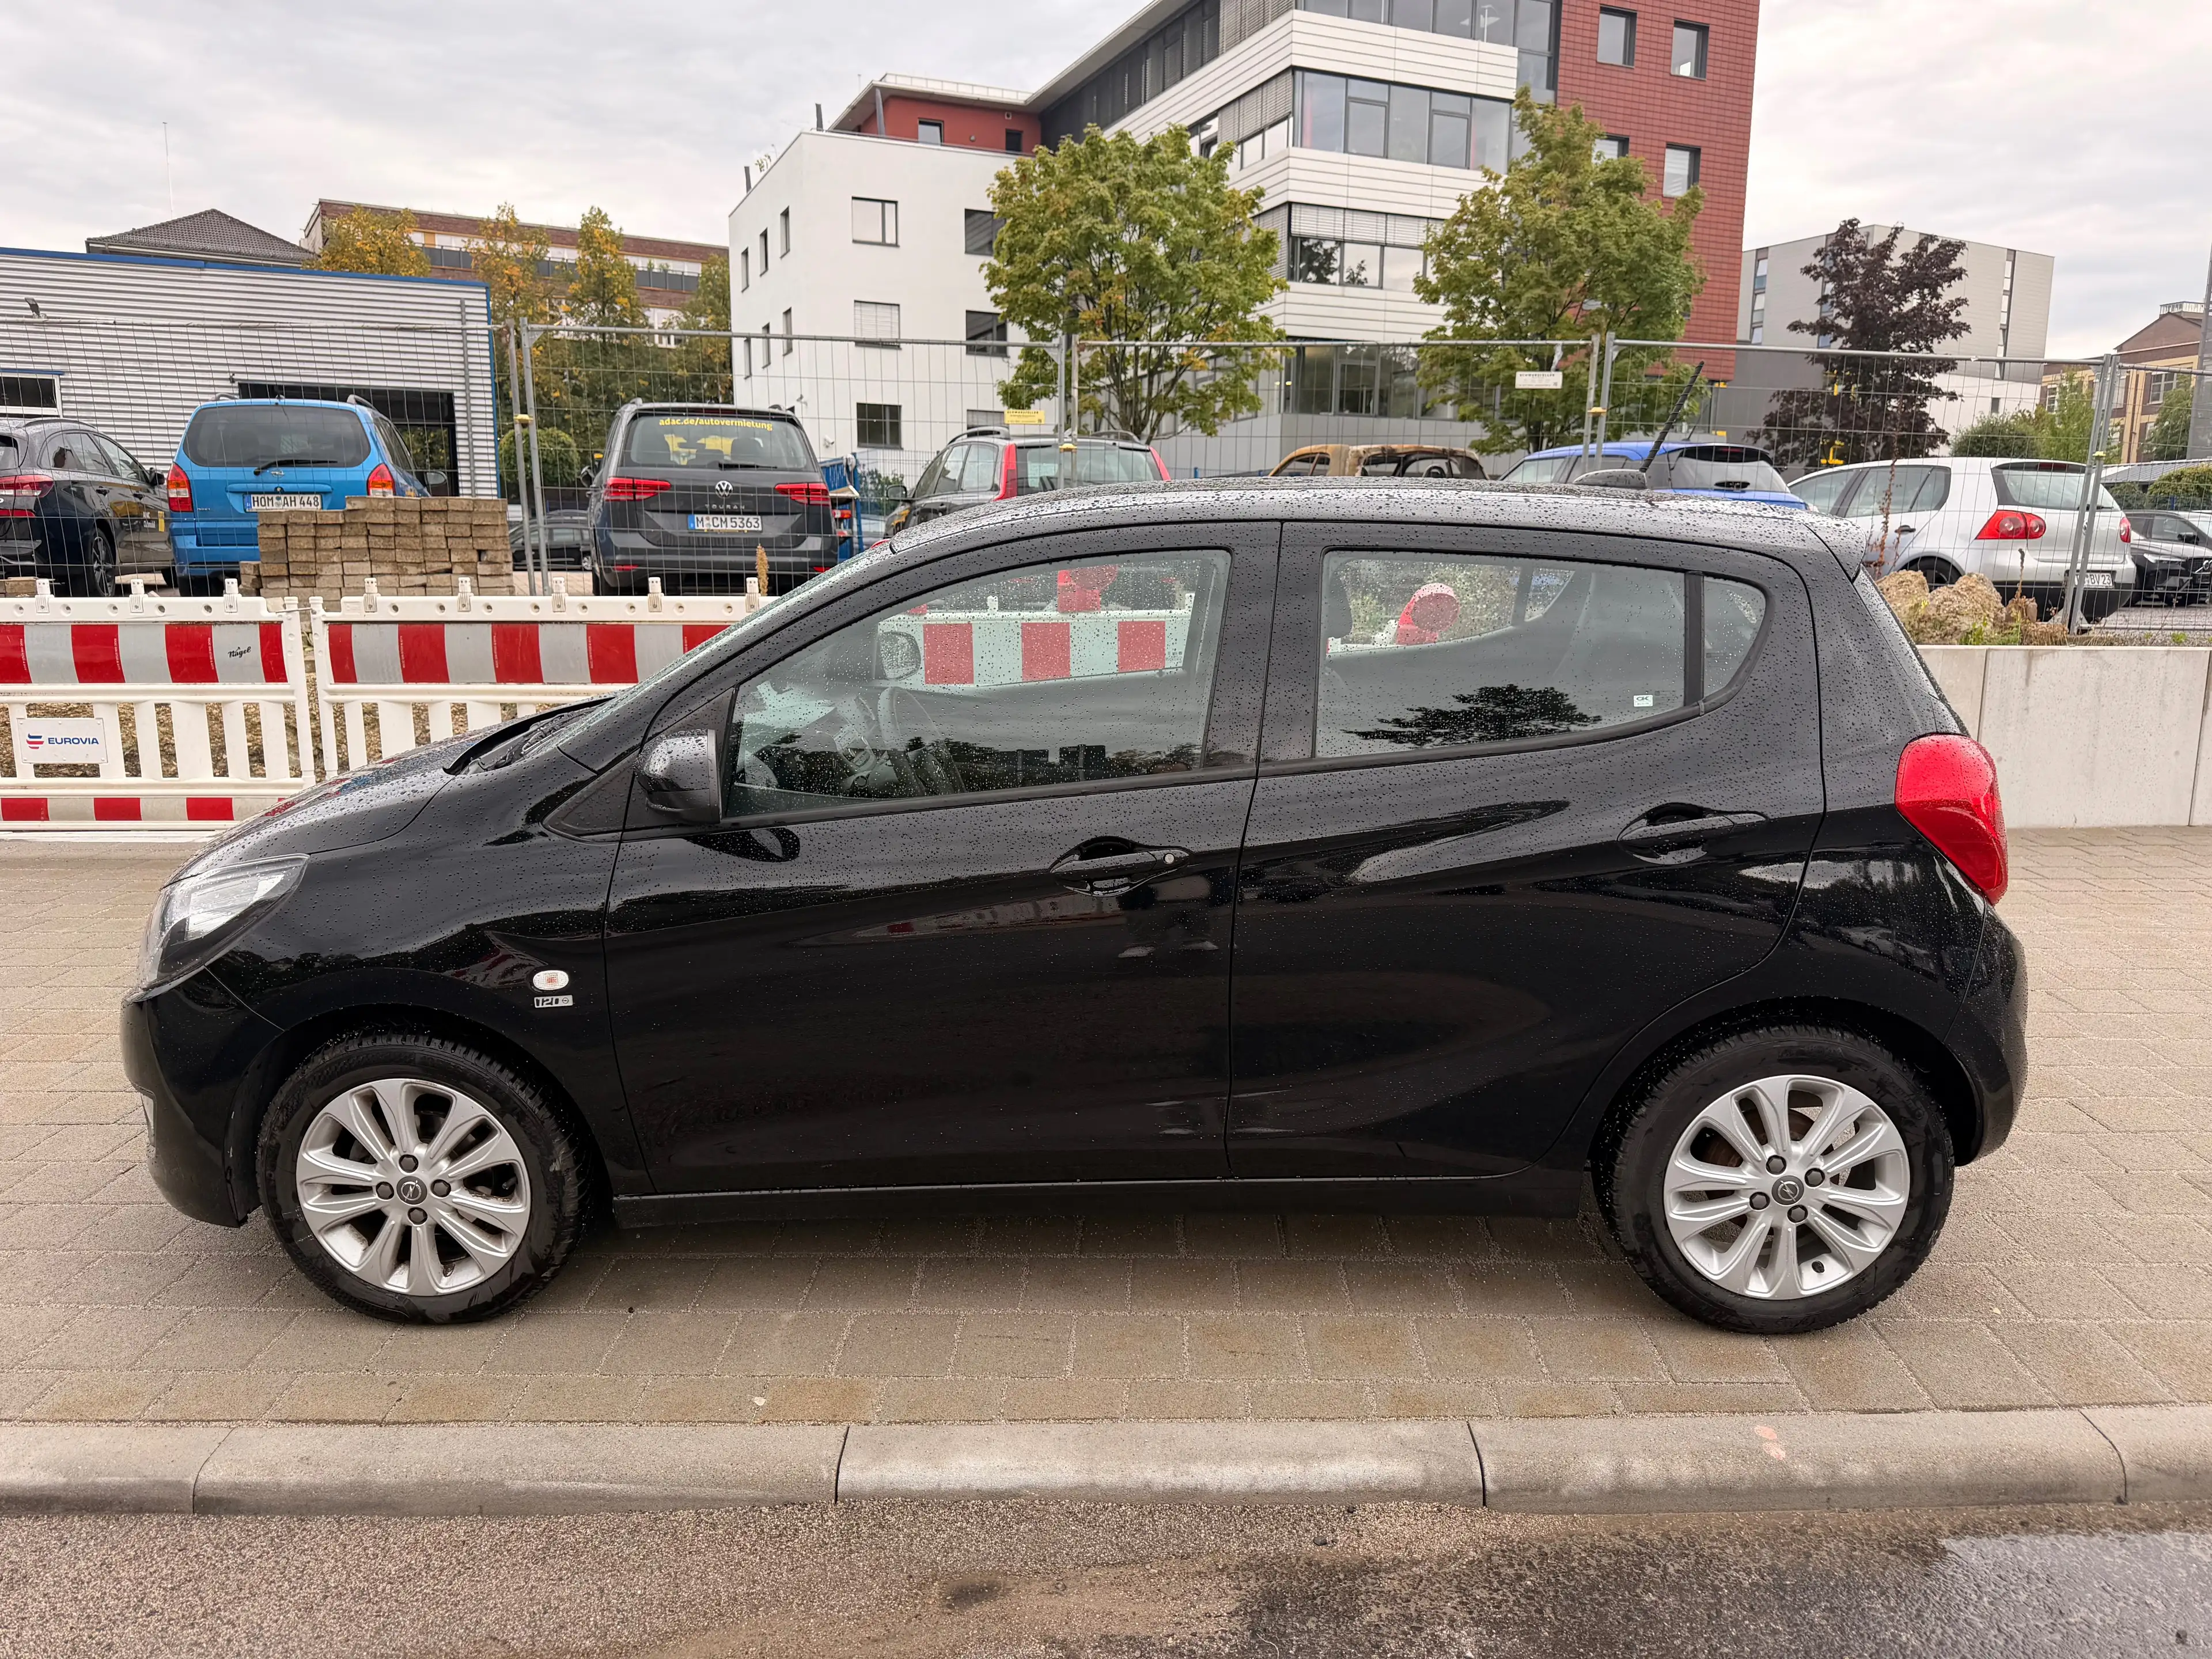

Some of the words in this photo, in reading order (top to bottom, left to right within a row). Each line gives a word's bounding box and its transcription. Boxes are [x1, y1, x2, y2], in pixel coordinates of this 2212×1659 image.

[659, 417, 772, 431] adac.de/autovermietung
[252, 496, 274, 507] HOM
[283, 496, 297, 507] AH
[300, 496, 320, 507] 448
[696, 517, 704, 528] M
[712, 517, 728, 528] CM
[730, 517, 760, 528] 5363
[2089, 574, 2100, 585] BV
[2101, 574, 2111, 585] 23
